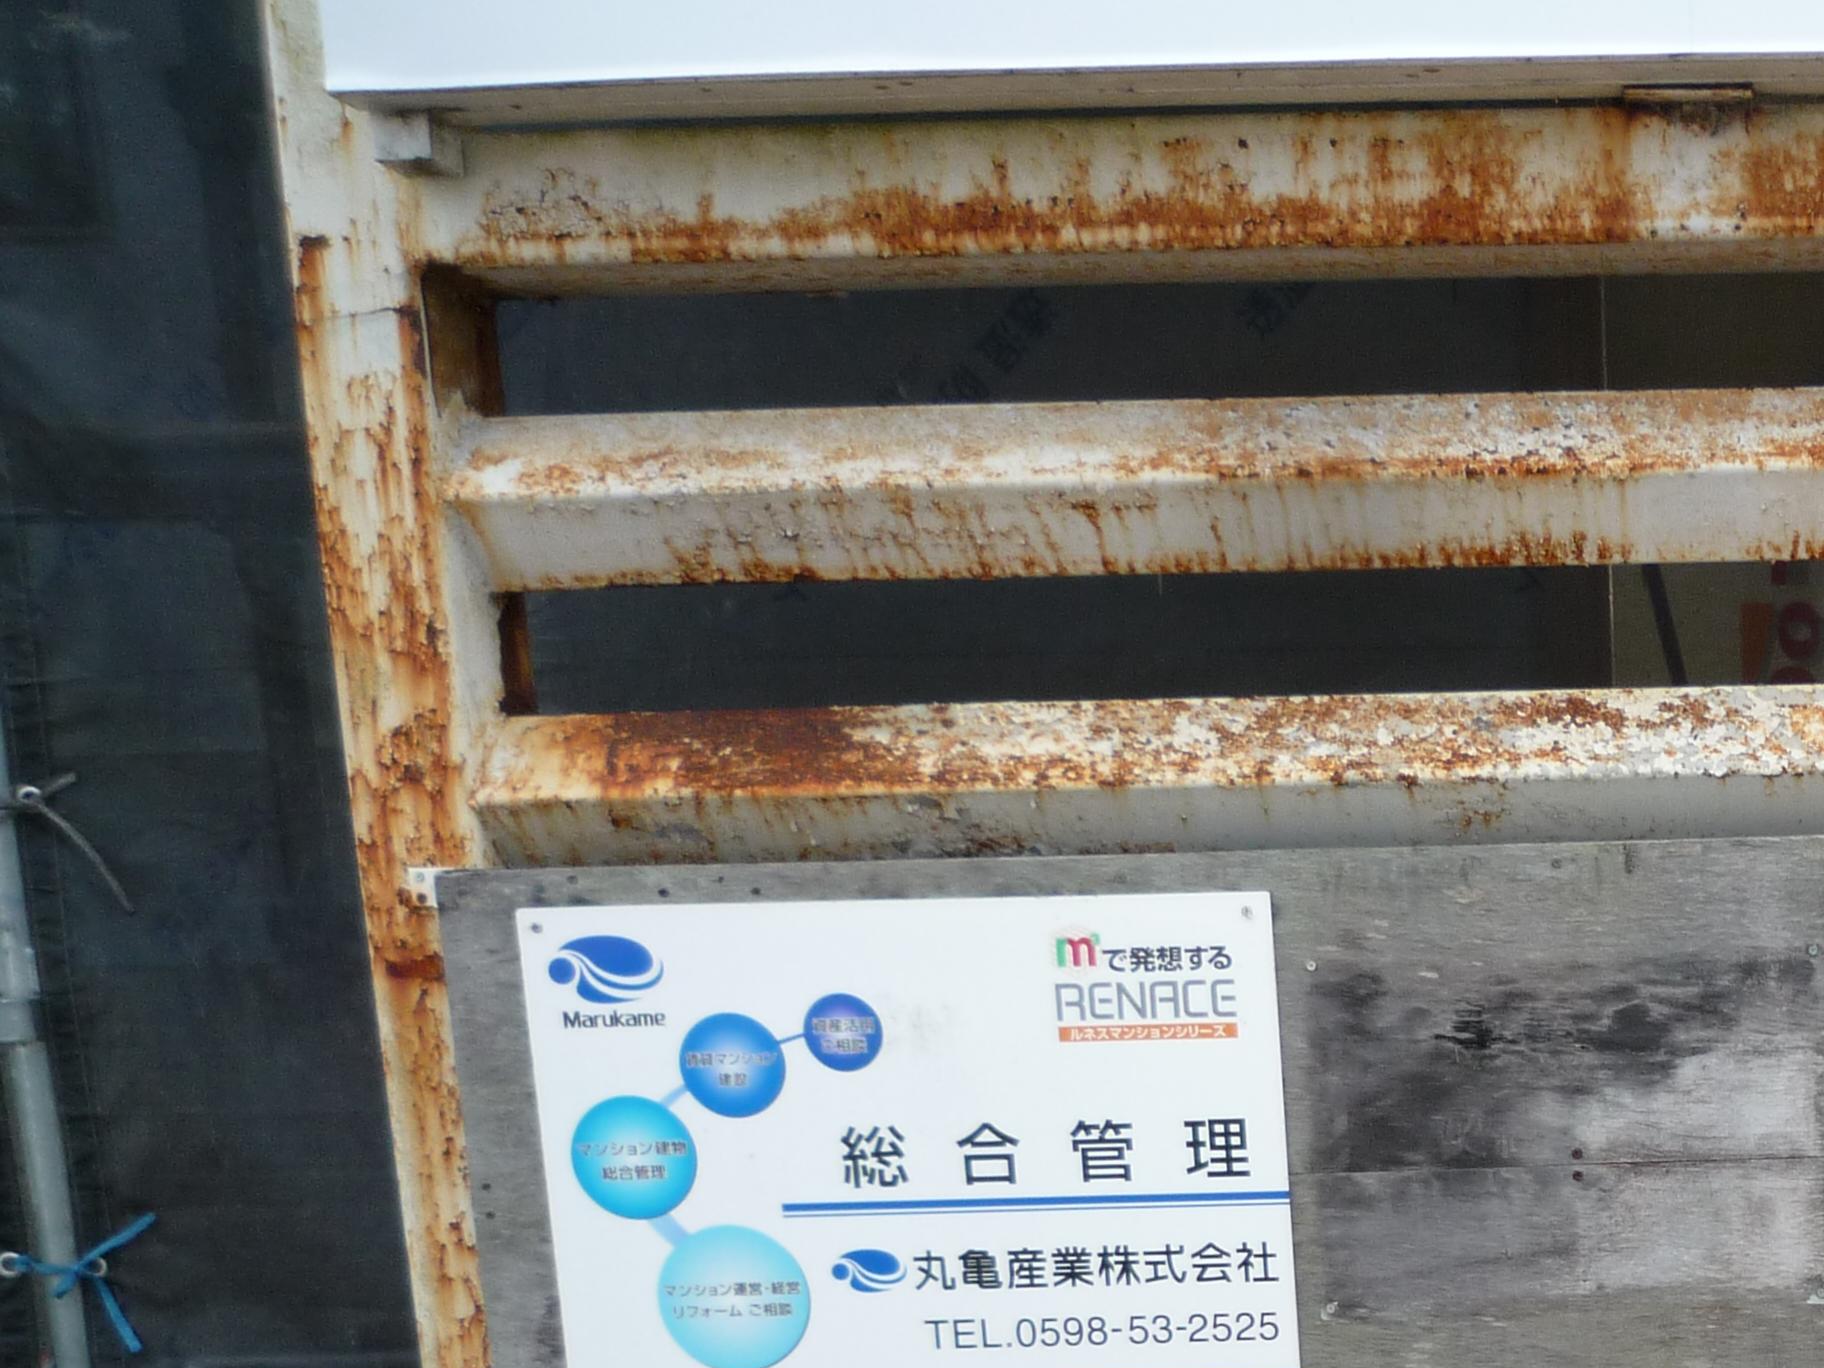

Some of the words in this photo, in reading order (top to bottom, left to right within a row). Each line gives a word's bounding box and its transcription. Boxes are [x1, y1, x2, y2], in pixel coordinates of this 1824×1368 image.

[1055, 979, 1238, 1021] RENACE
[562, 1009, 666, 1030] Marukame
[1070, 1024, 1227, 1041] ルネスマンションシリーズ
[579, 1140, 688, 1157] マンション建物
[841, 1117, 1251, 1188] 総合管理
[601, 1165, 666, 1181] 総合管理
[914, 1242, 1280, 1292] 丸亀産業株式会社
[673, 1304, 743, 1319] リフォーム
[749, 1303, 793, 1317] ご相談
[925, 1312, 1280, 1352] TEL.0598-53-2525
